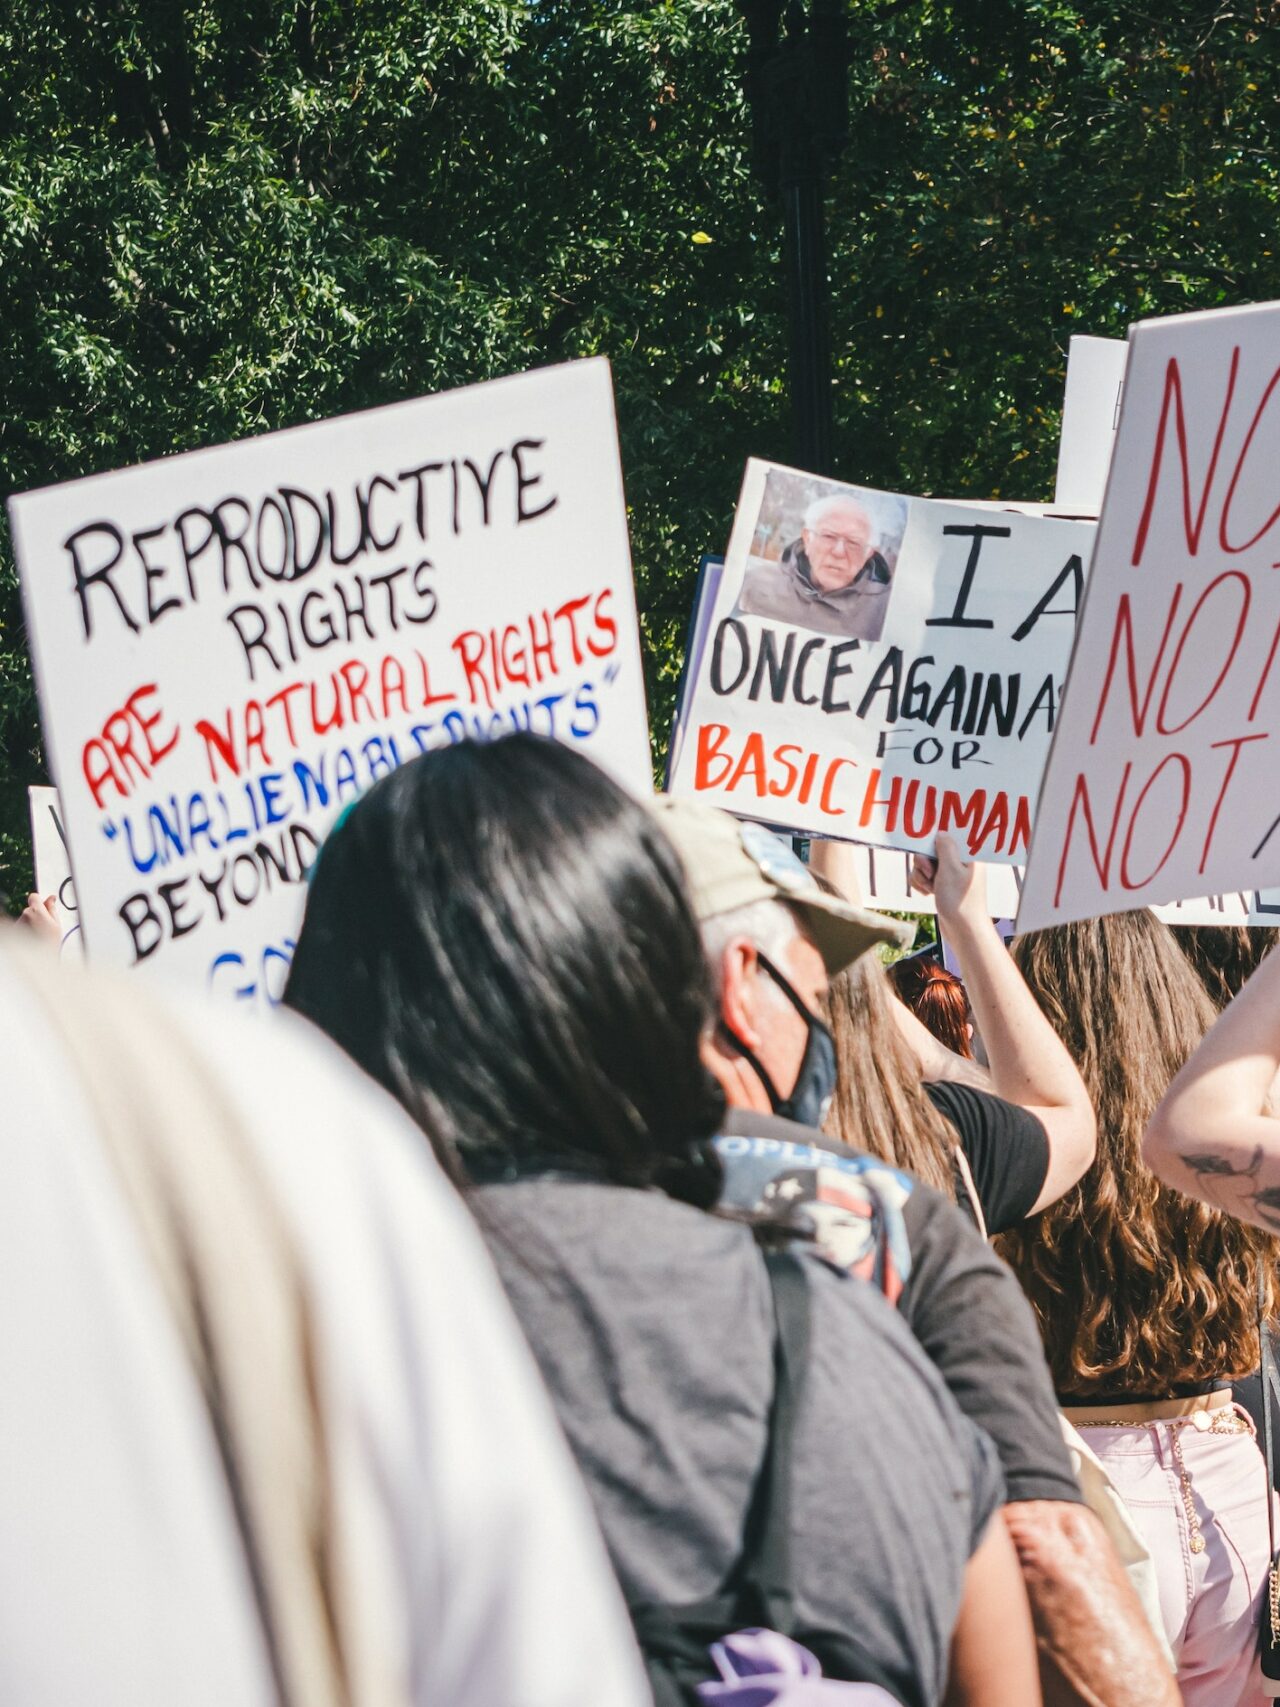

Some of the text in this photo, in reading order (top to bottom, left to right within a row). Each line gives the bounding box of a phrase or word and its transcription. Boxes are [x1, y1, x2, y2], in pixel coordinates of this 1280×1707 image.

[63, 438, 560, 645] REPRODUCTIVE
[925, 524, 1011, 630] I
[226, 560, 439, 681] RIGHTS
[708, 616, 1064, 742] ONCE AGAIN A
[81, 586, 621, 811] ARE NATURAL RIGHTS
[876, 728, 995, 769] FOR
[693, 723, 1032, 857] BASIC HUMAN
[1053, 732, 1269, 909] NOT
[117, 823, 321, 970] BEYOND
[209, 939, 298, 1008] GO
